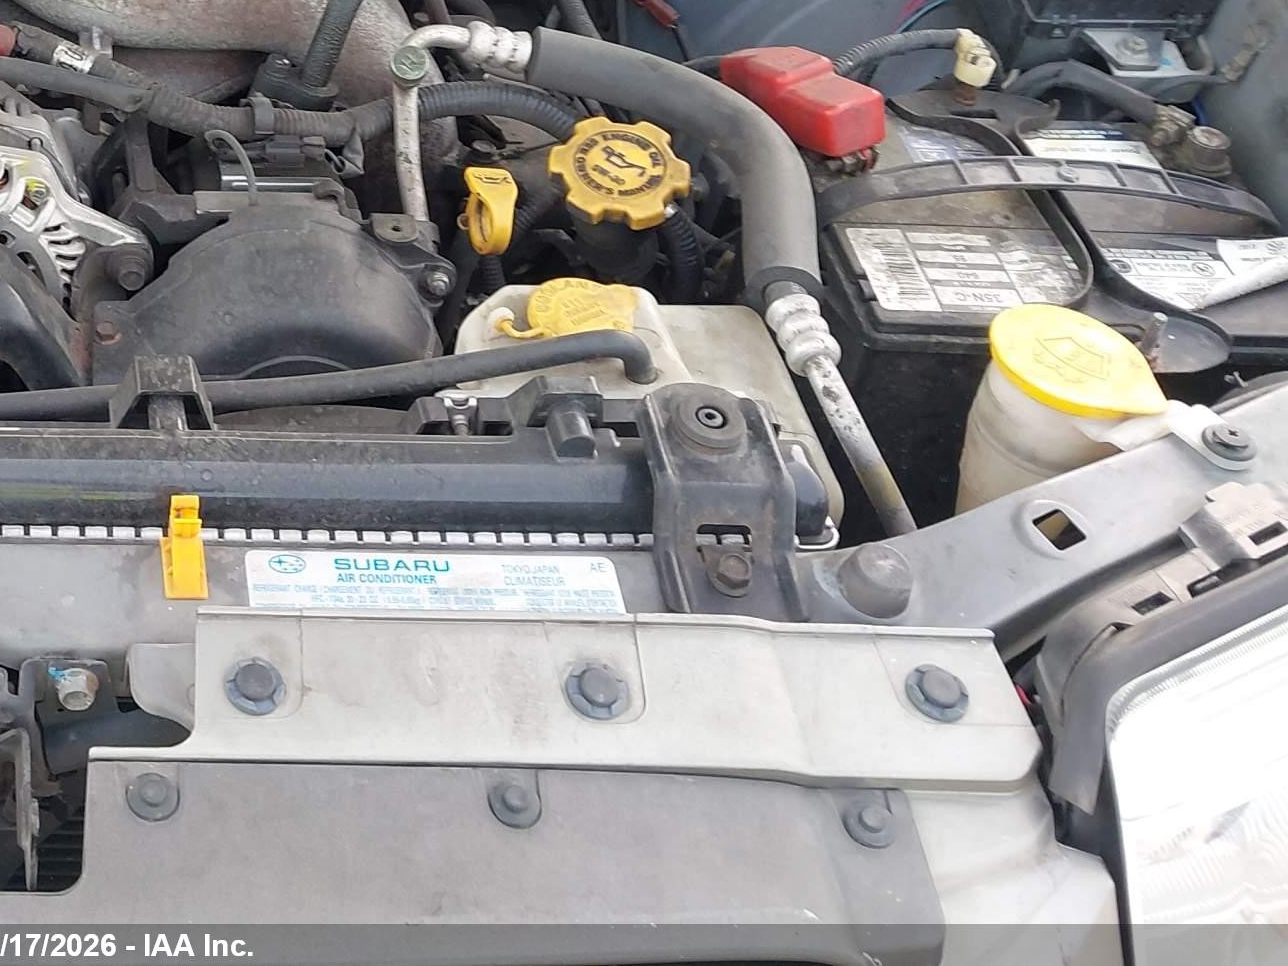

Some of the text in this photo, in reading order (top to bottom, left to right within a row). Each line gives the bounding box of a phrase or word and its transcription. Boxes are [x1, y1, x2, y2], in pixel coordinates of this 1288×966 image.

[334, 558, 450, 572] SUBARU
[336, 573, 437, 584] AIR CONDITIONER
